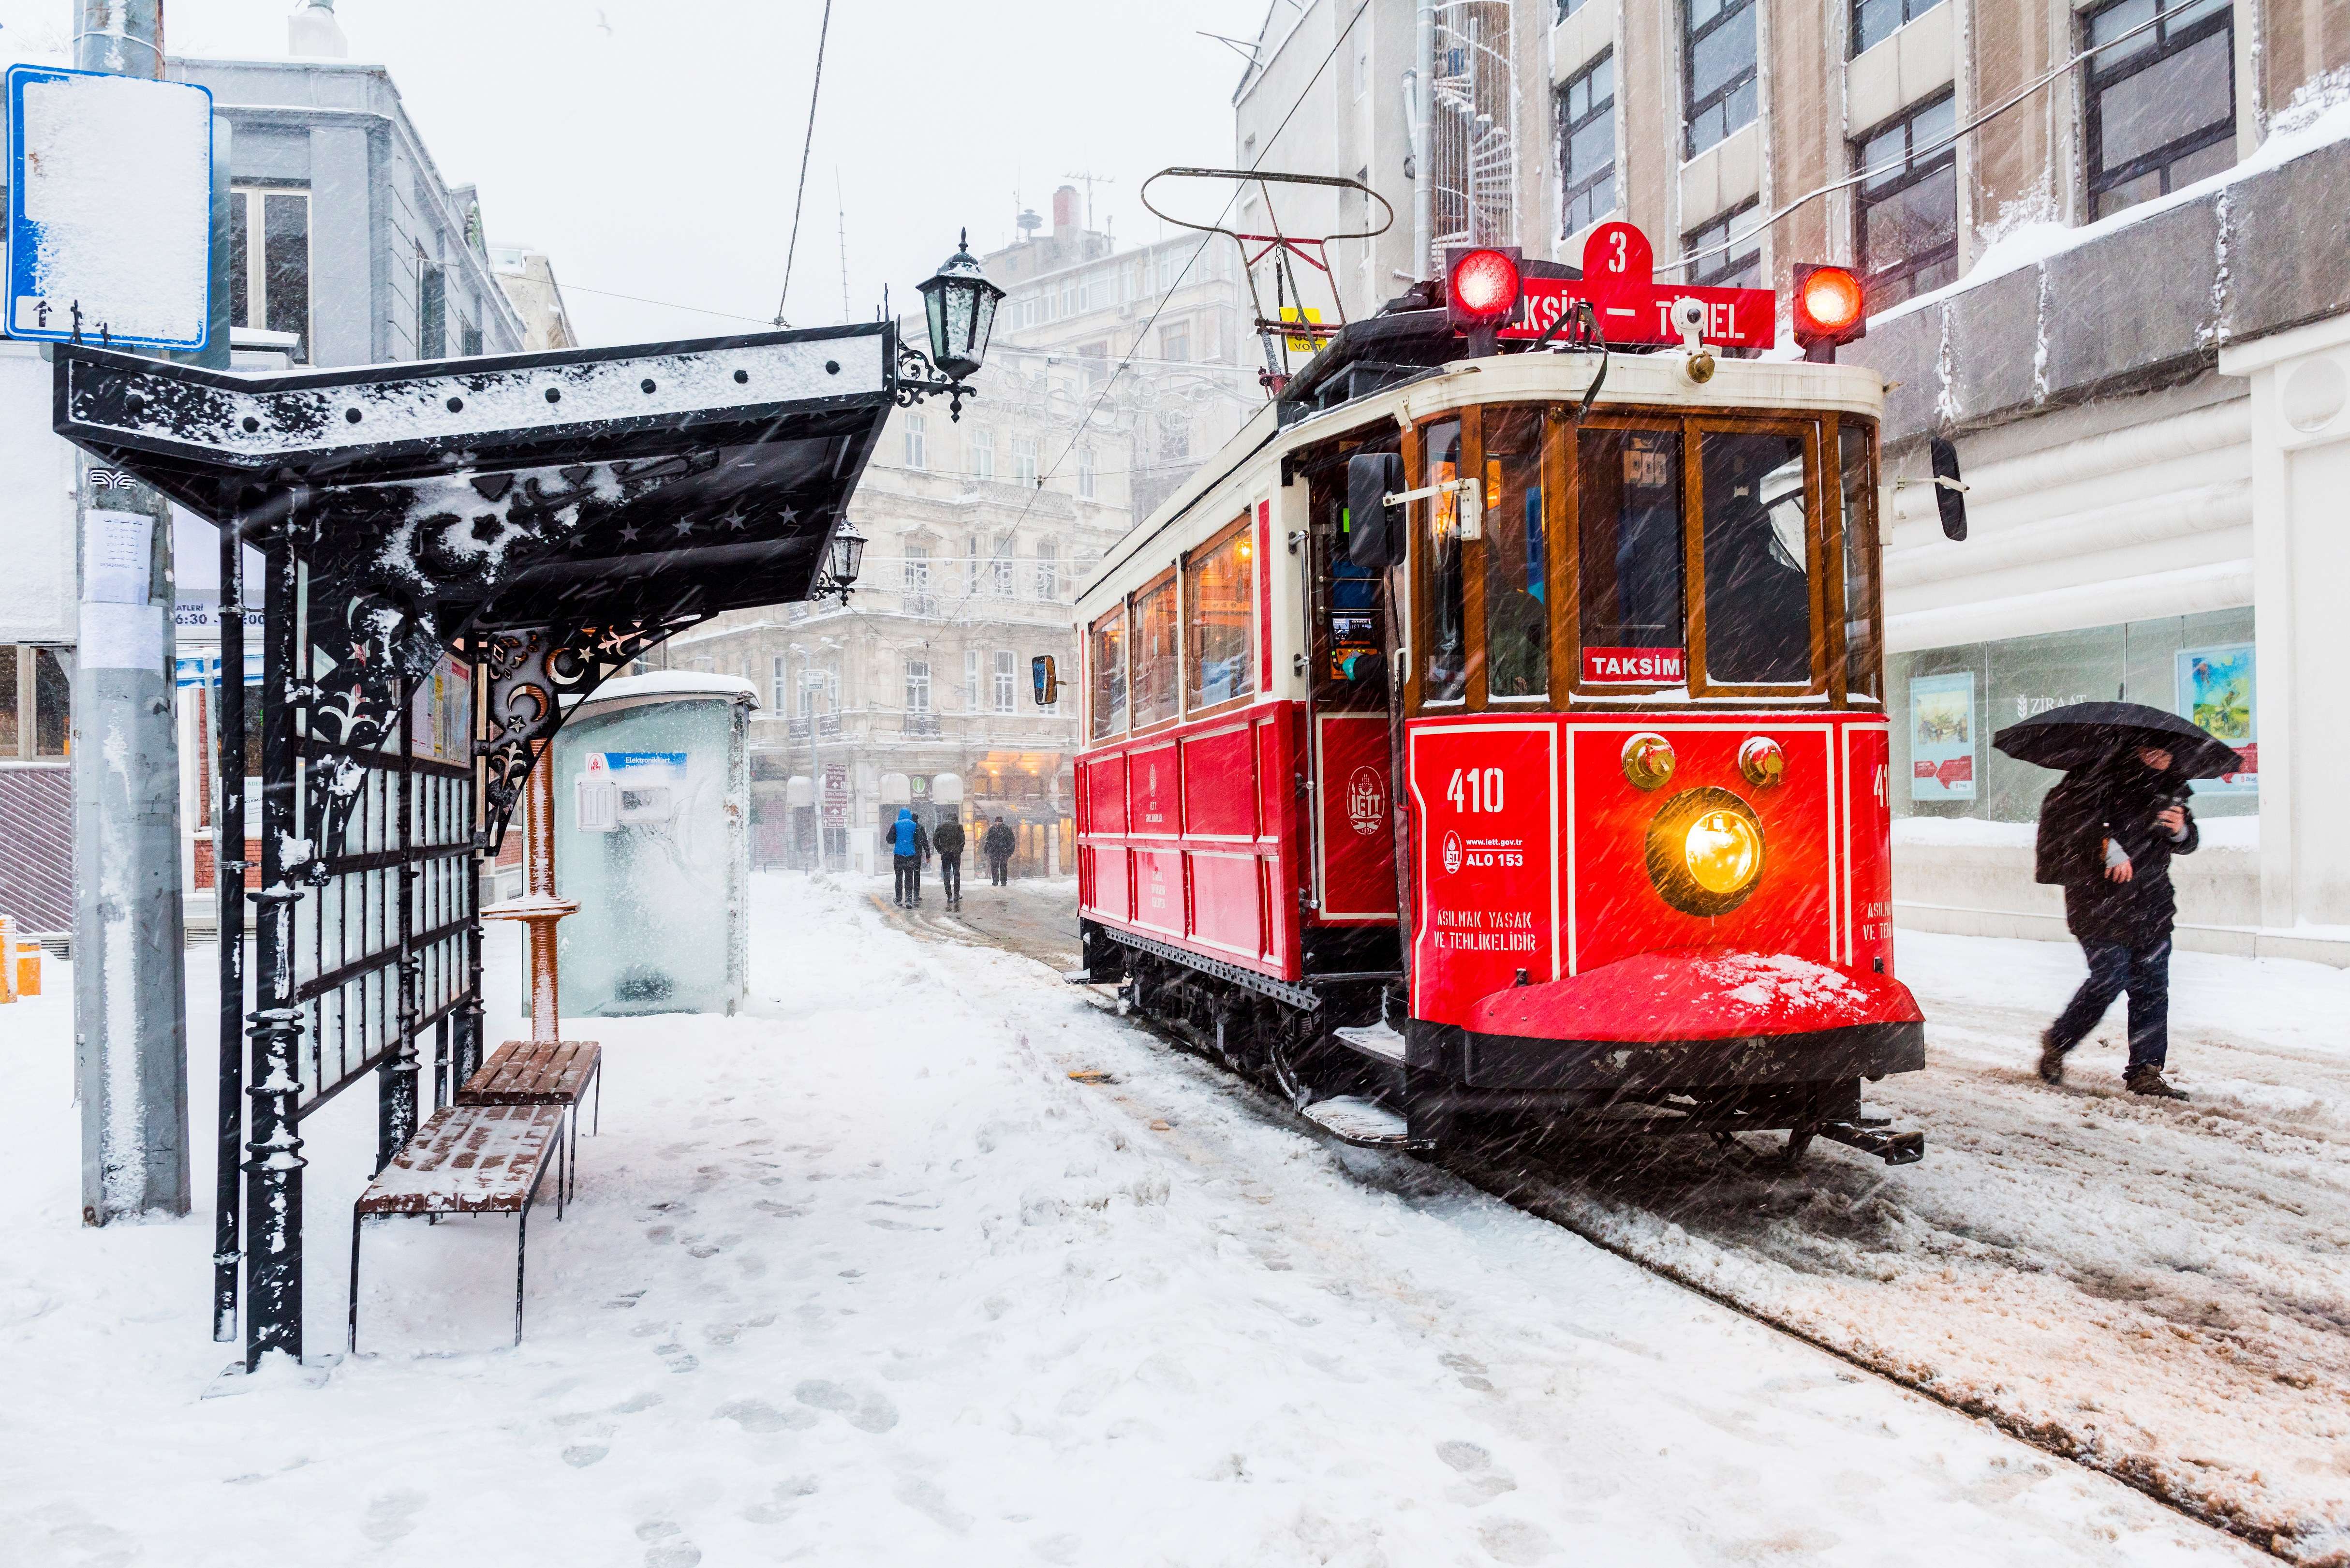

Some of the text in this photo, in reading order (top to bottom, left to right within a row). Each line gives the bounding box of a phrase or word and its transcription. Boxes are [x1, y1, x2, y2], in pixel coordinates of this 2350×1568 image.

[1609, 231, 1626, 273] 3
[1592, 655, 1680, 675] TAKSİM
[1447, 768, 1504, 813] 410
[1466, 854, 1523, 866] ALO 153
[1437, 910, 1531, 928] ASILMAK YASAK
[1434, 931, 1536, 951] VE TEHLİKELİDİR
[1863, 924, 1876, 940] VE
